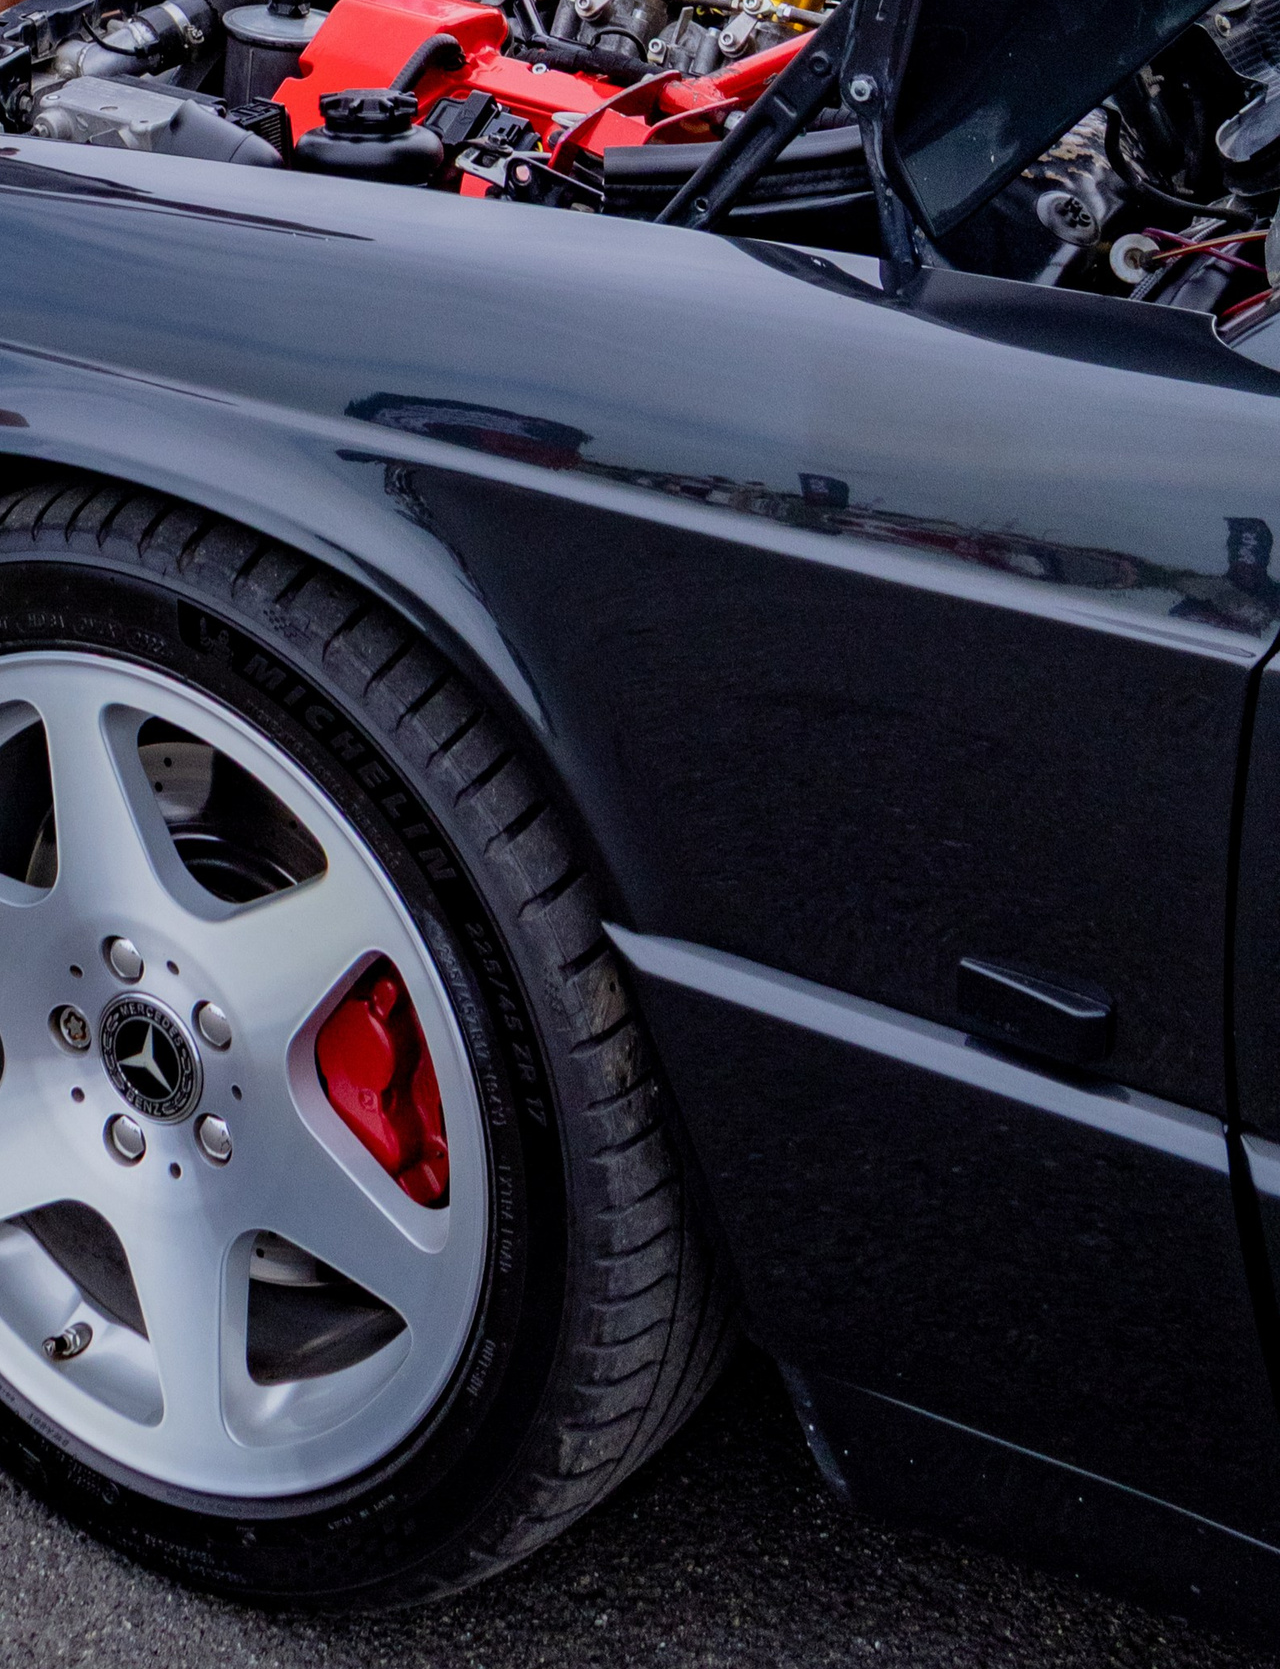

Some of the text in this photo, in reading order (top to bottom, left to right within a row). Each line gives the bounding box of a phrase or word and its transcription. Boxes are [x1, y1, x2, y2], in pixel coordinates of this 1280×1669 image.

[245, 653, 548, 1128] MICHELIN 225/45 ZR 17
[120, 1003, 184, 1047] MERCEDES
[125, 1089, 162, 1116] BENZ
